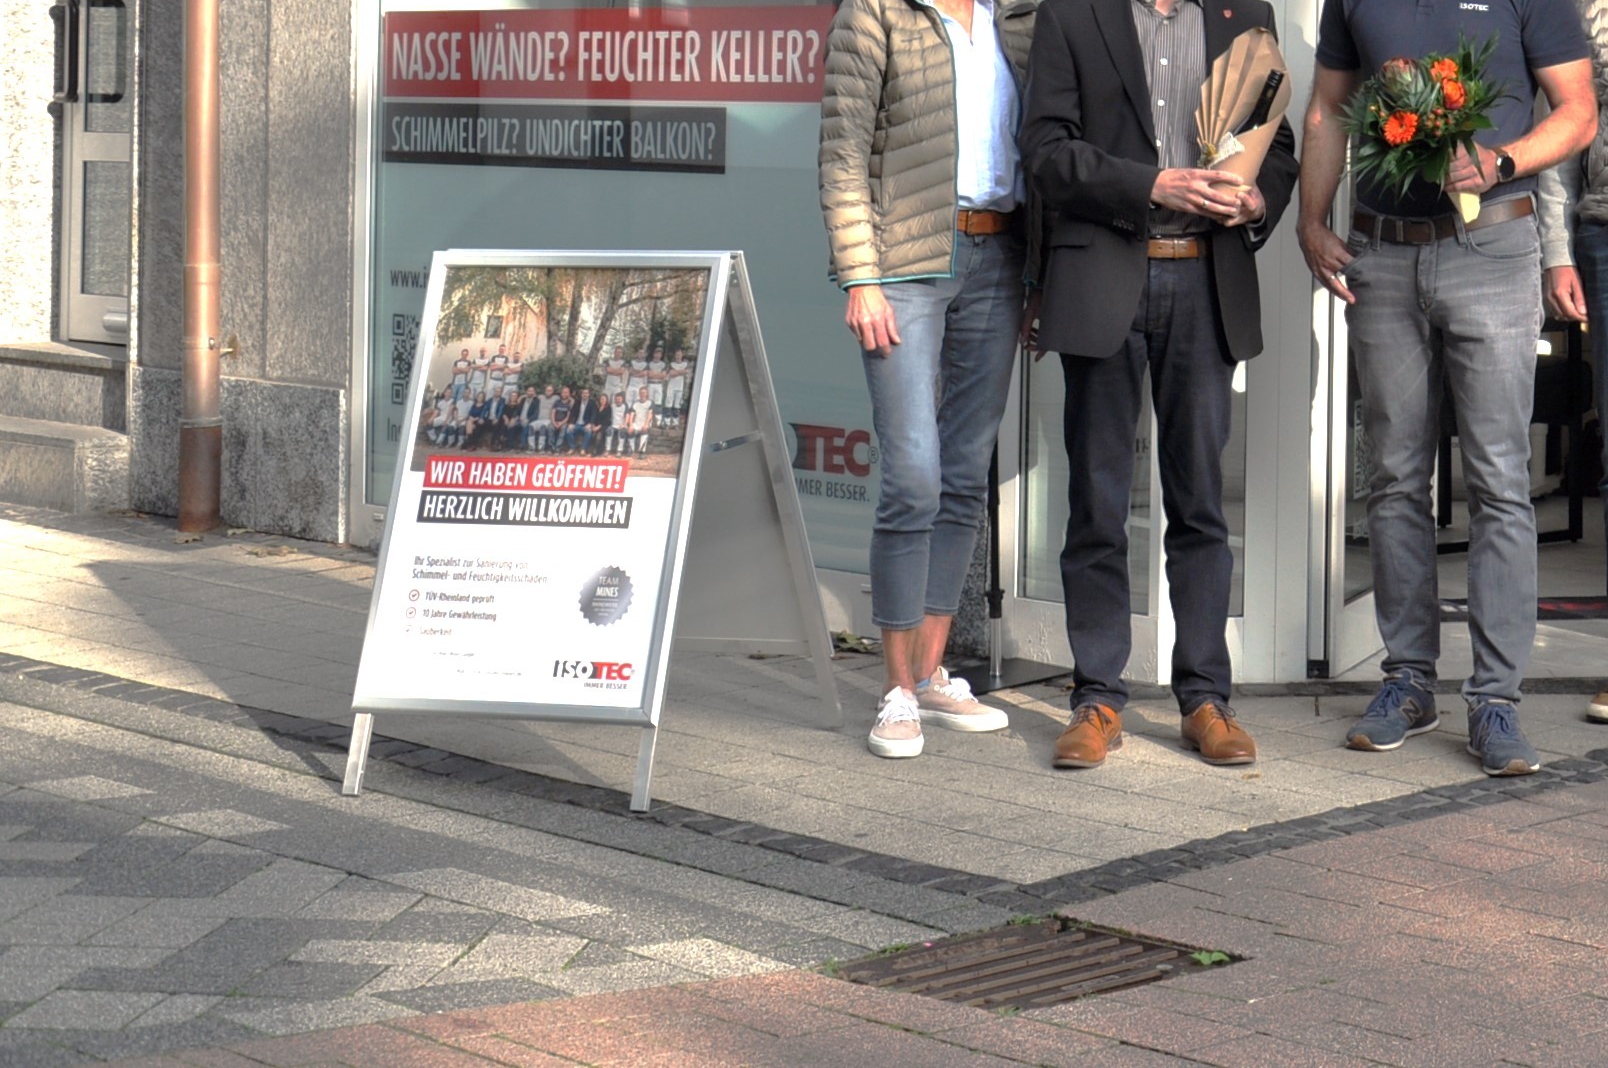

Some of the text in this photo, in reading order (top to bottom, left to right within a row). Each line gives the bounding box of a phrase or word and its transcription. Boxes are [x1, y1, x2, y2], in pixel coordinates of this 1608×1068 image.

[392, 23, 821, 84] NASSE WÄNDE? FEUCHTER KELLER?
[391, 116, 716, 162] SCHIMMELPILZ? UNDICHTER BALKON?
[431, 460, 624, 489] WIR HABEN GEÖFFNET!
[826, 481, 871, 502] BESSER.
[423, 494, 628, 525] HERZLICH WILLKOMMEN
[426, 556, 461, 568] Spezialist
[452, 571, 468, 581] und
